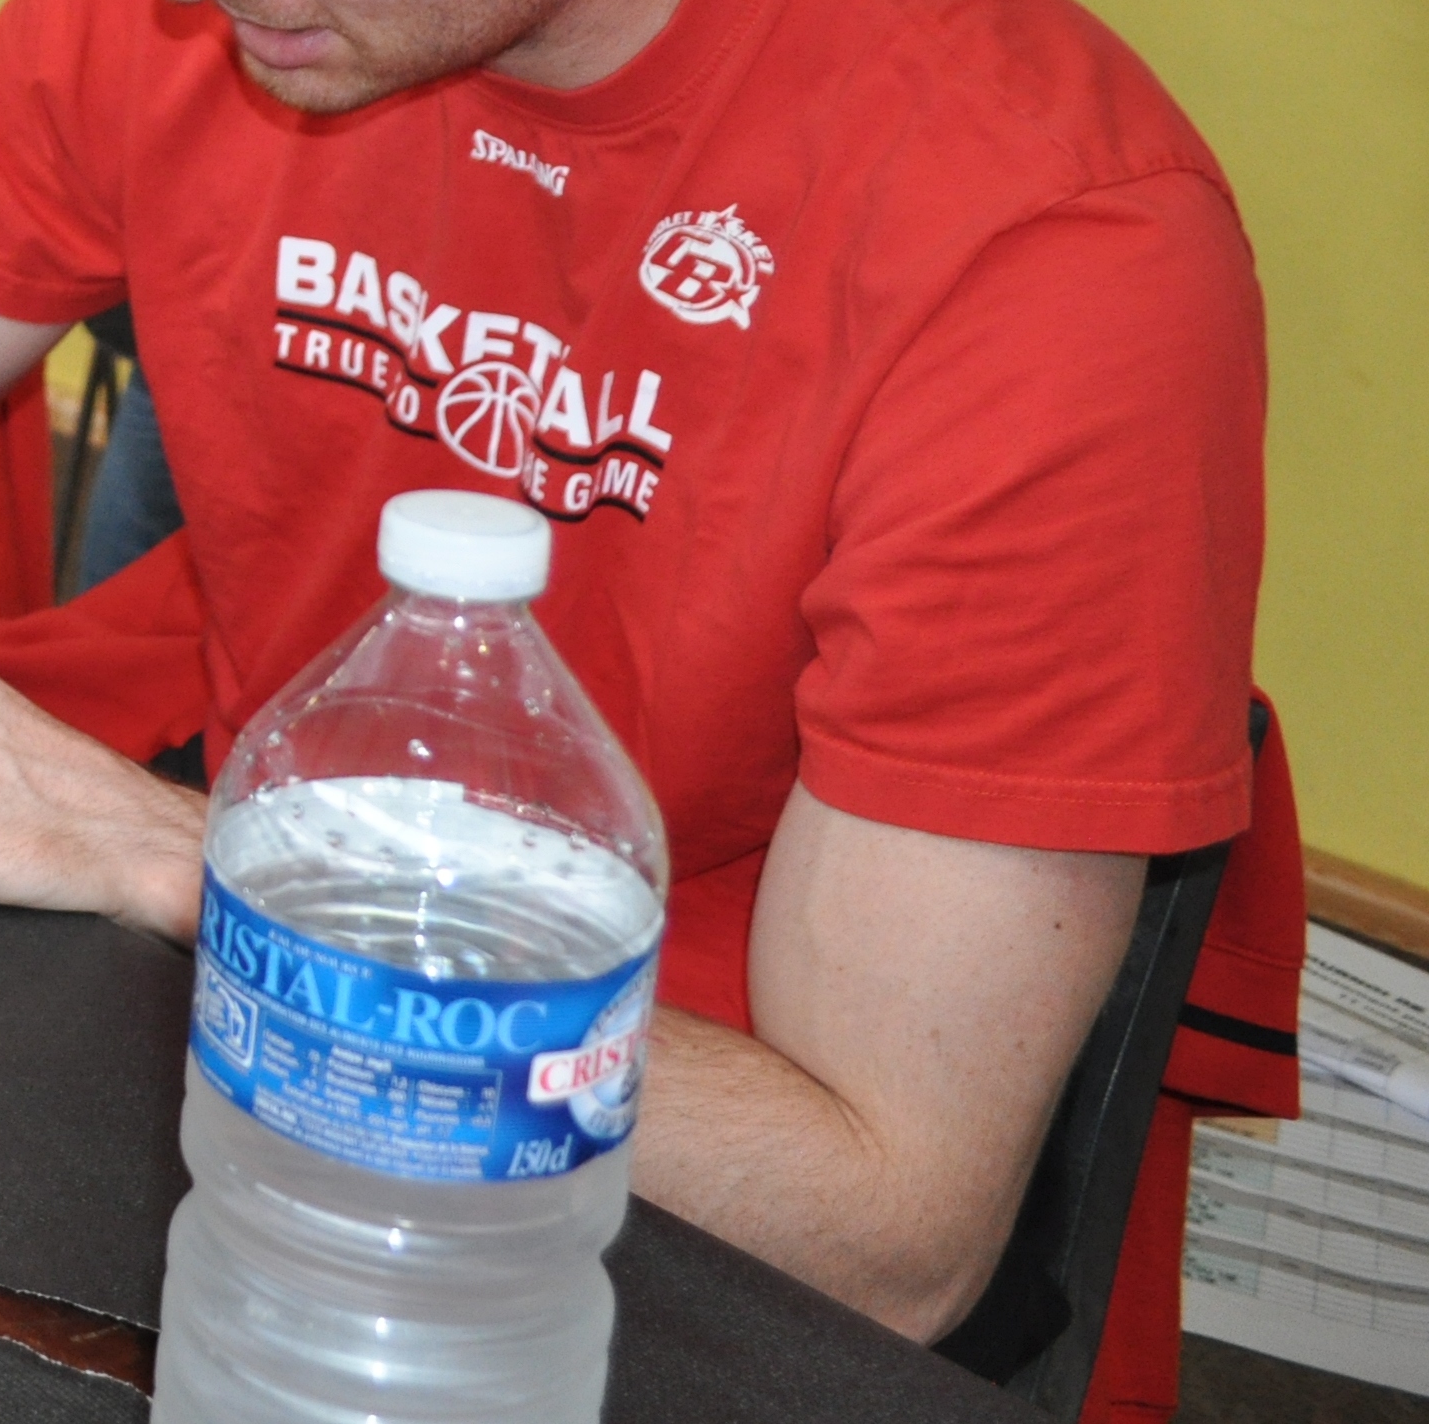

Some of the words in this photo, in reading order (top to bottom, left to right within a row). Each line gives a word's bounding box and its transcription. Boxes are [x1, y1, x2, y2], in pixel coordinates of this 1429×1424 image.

[276, 235, 673, 452] BASKETALL
[564, 457, 661, 514] GME
[201, 893, 547, 1053] RISTAL-ROC
